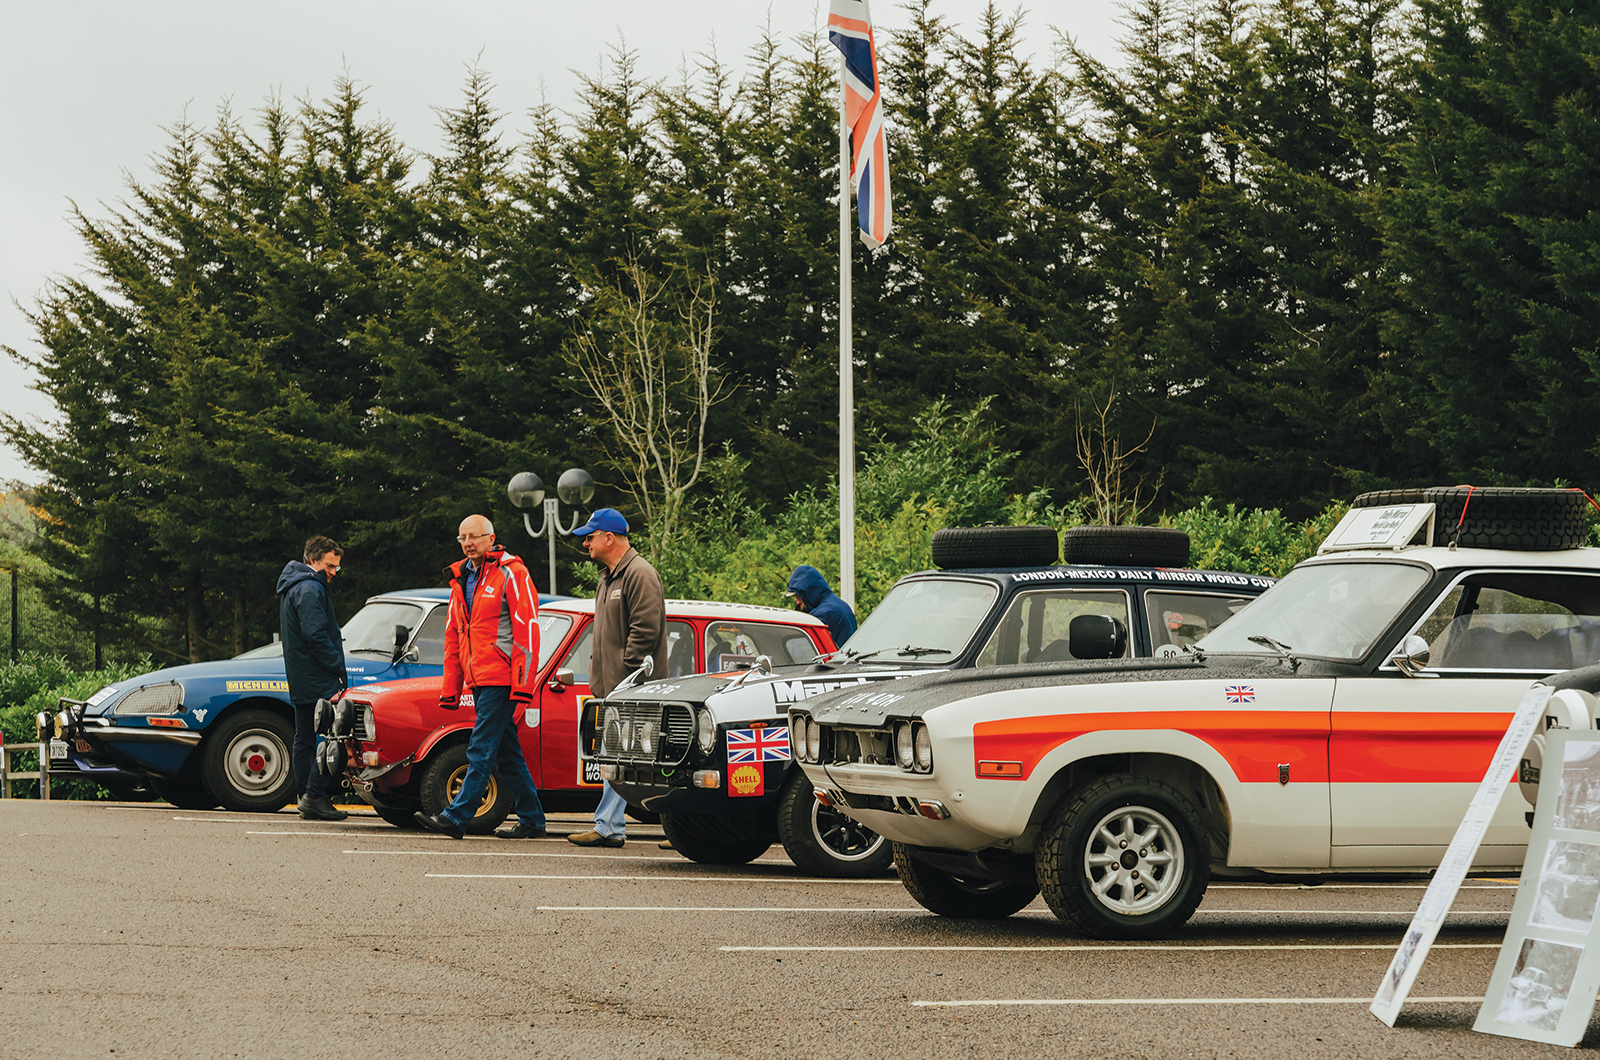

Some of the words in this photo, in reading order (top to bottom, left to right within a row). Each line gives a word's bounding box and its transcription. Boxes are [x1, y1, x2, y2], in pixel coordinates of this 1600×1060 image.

[1012, 570, 1116, 581] LONDON-MEXICO
[1118, 571, 1153, 580] DAILY
[1155, 571, 1205, 582] MIRROR
[1205, 574, 1249, 585] WORLD
[1250, 578, 1275, 588] CUP
[228, 681, 289, 691] MICHELIN
[586, 771, 602, 780] WO
[734, 775, 758, 784] SHELL
